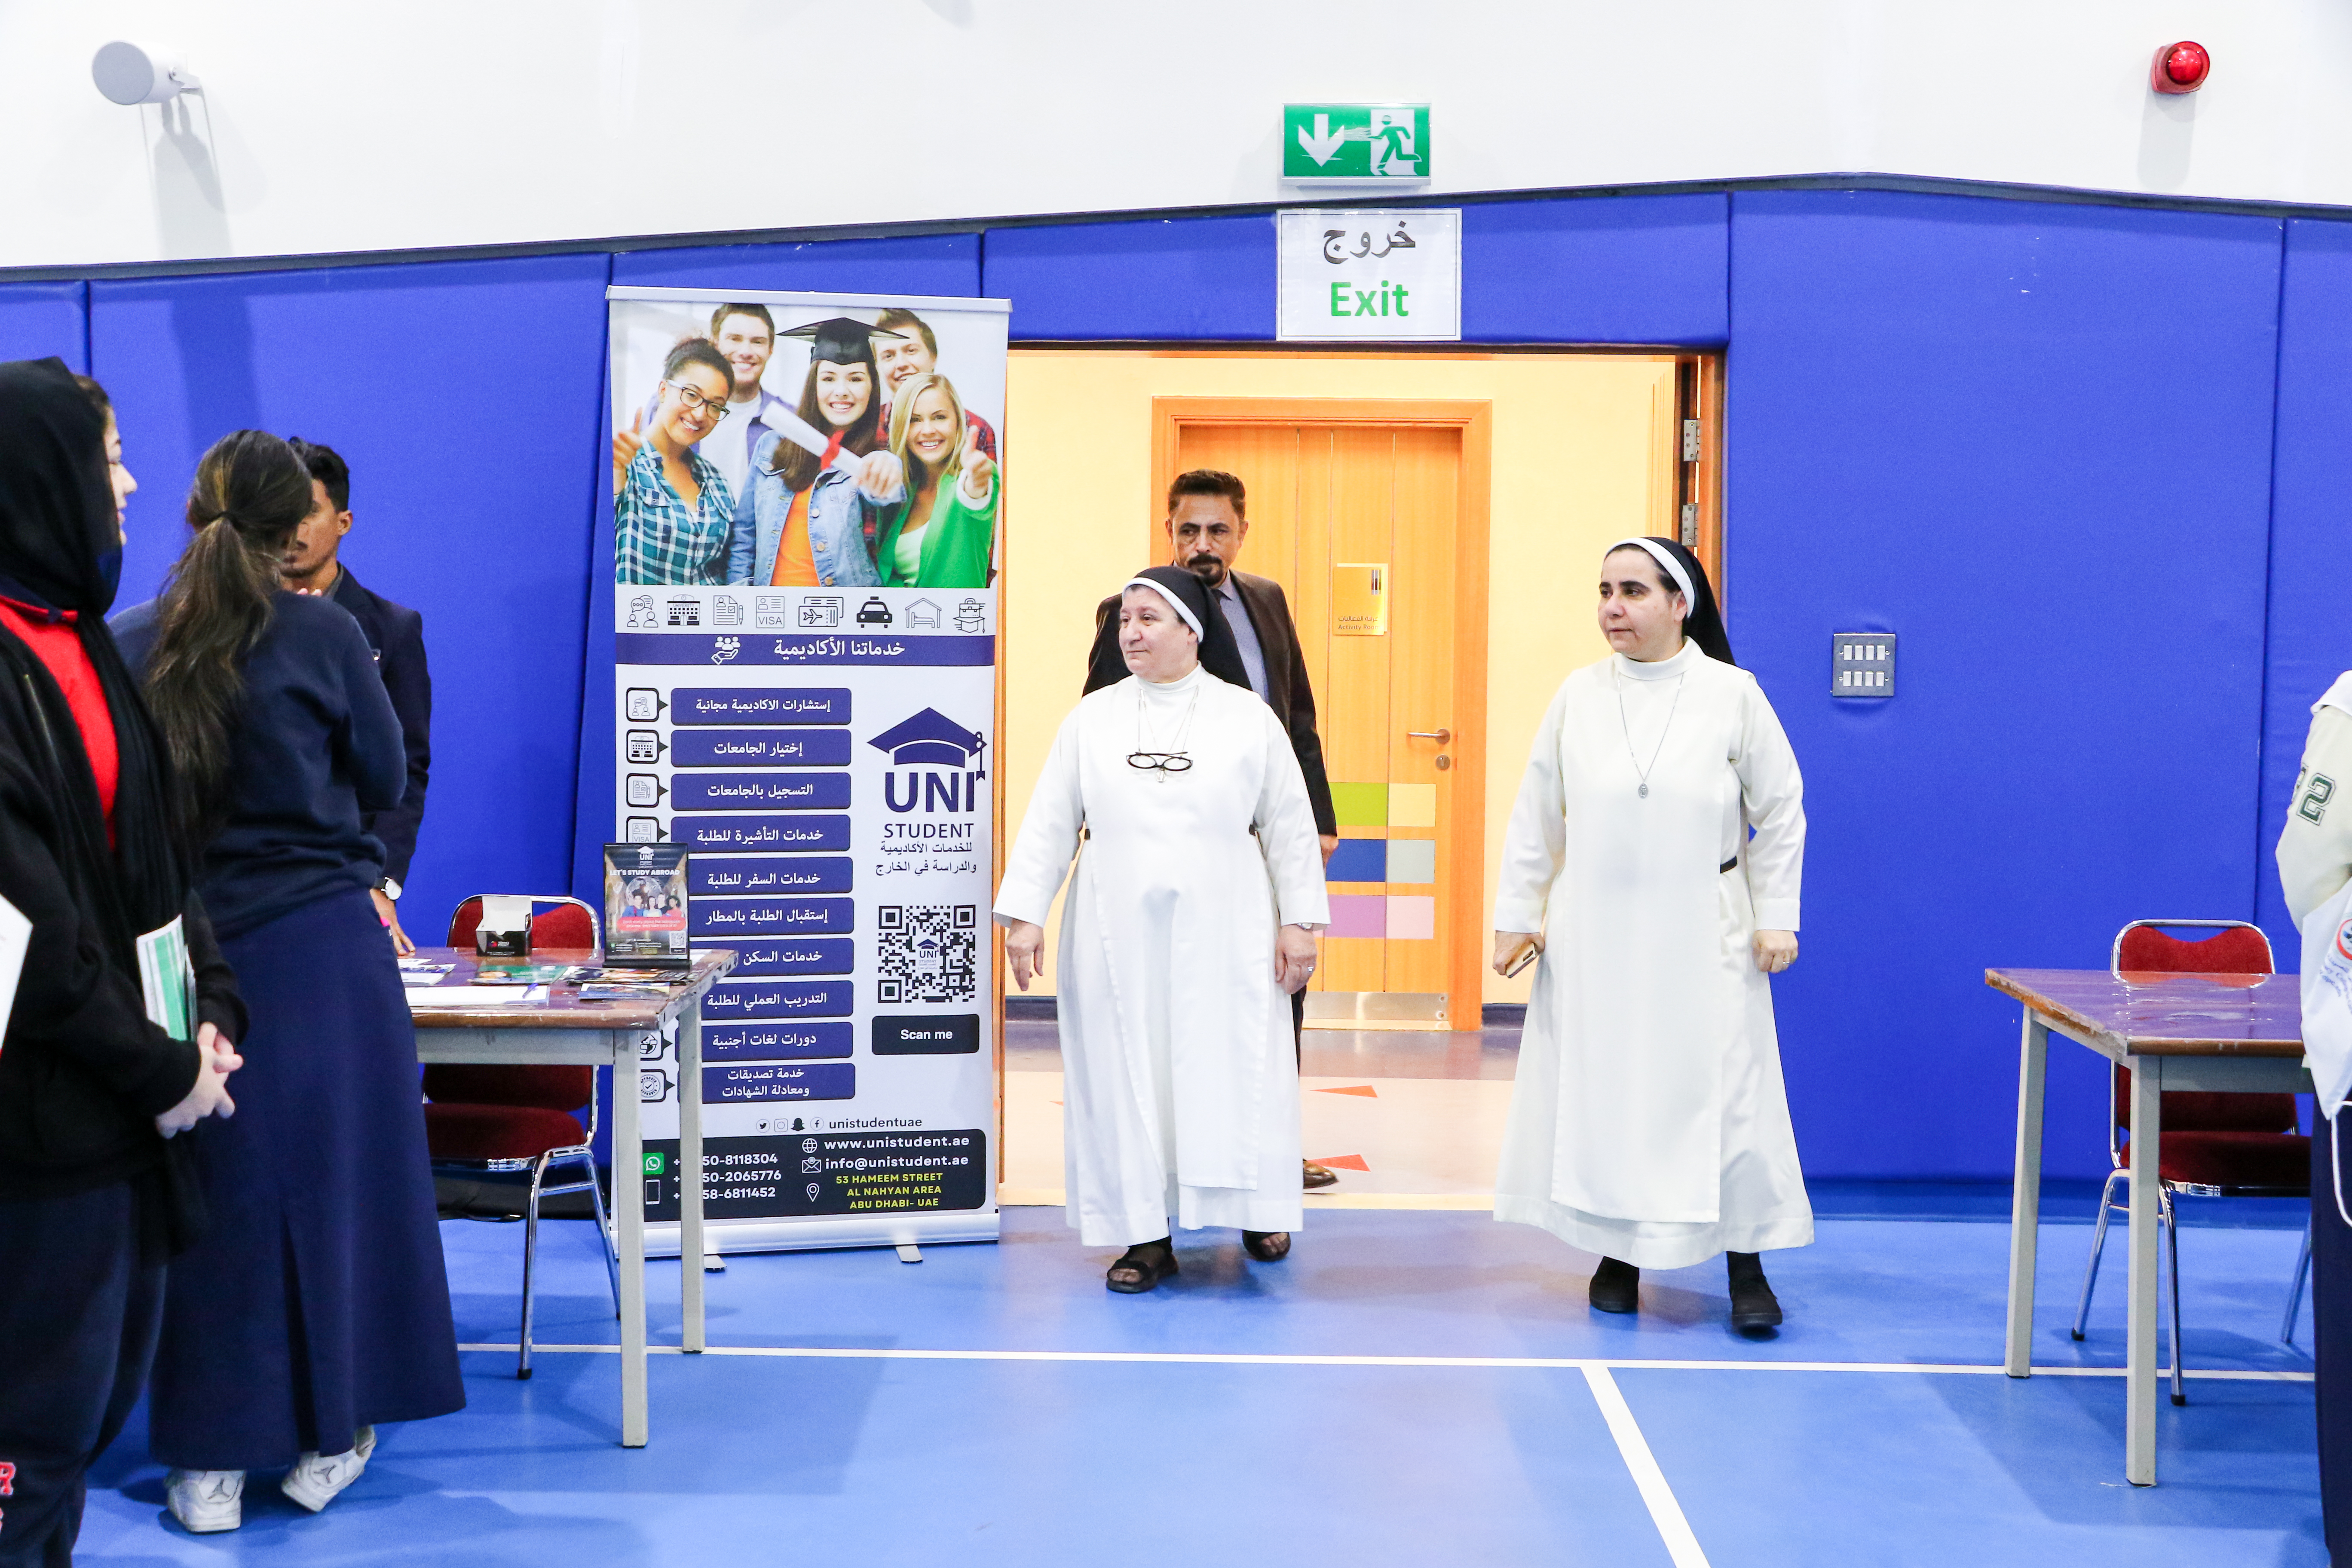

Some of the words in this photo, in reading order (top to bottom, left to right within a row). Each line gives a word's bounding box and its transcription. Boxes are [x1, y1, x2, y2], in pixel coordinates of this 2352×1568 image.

[1323, 220, 1416, 265] خروج
[1331, 280, 1409, 317] Exit
[758, 616, 782, 625] VISA
[774, 637, 845, 660] الأكاديمية
[851, 640, 905, 655] خدماتنا
[696, 699, 728, 713] مجانية
[731, 699, 779, 713] الاكاديمية
[782, 699, 831, 713] إستشارات
[714, 742, 766, 756] الجامعات
[769, 742, 803, 757] إختيار
[707, 784, 764, 799] بالجامعات
[768, 784, 813, 799] التسجيل
[885, 772, 975, 813] UNI
[697, 829, 731, 844] للطلبة
[735, 827, 779, 845] التأشيرة
[783, 829, 824, 841] خدمات
[884, 823, 974, 838] STUDENT
[880, 841, 927, 855] الأكاديمية
[932, 842, 972, 852] للخدمات
[876, 861, 910, 876] الخارج
[914, 860, 928, 875] في
[933, 861, 977, 874] والدراسة
[707, 873, 741, 888] للطلبة
[745, 873, 776, 888] السفر
[781, 872, 821, 885] خدمات
[705, 910, 745, 925] بالمطار
[750, 909, 782, 925] الطلبة
[787, 909, 828, 924] إستقبال
[743, 950, 778, 966] السكن
[782, 950, 822, 962] خدمات
[707, 994, 740, 1009] للطلبة
[744, 993, 780, 1011] العملي
[784, 992, 827, 1008] التدريب
[713, 1031, 746, 1050] أجنبية
[750, 1033, 777, 1045] لغات
[781, 1033, 817, 1047] دورات
[900, 1029, 931, 1040] Scan
[934, 1031, 953, 1039] me
[728, 1069, 773, 1082] تصديقات
[777, 1068, 805, 1078] خدمة
[722, 1085, 767, 1099] الشهادات
[771, 1084, 810, 1097] ومعادلة
[829, 1117, 922, 1129] unistudentuae
[824, 1136, 969, 1150] www.unistudent.ae
[825, 1156, 969, 1170] info@unistudent.ae
[836, 1176, 848, 1184] 53
[852, 1174, 899, 1183] HAMEEM
[902, 1173, 943, 1182] STREET
[847, 1188, 861, 1197] AL
[864, 1186, 910, 1196] NAHYAN
[913, 1185, 942, 1194] AREA
[849, 1200, 872, 1209] ABU
[917, 1198, 938, 1207] UAE
